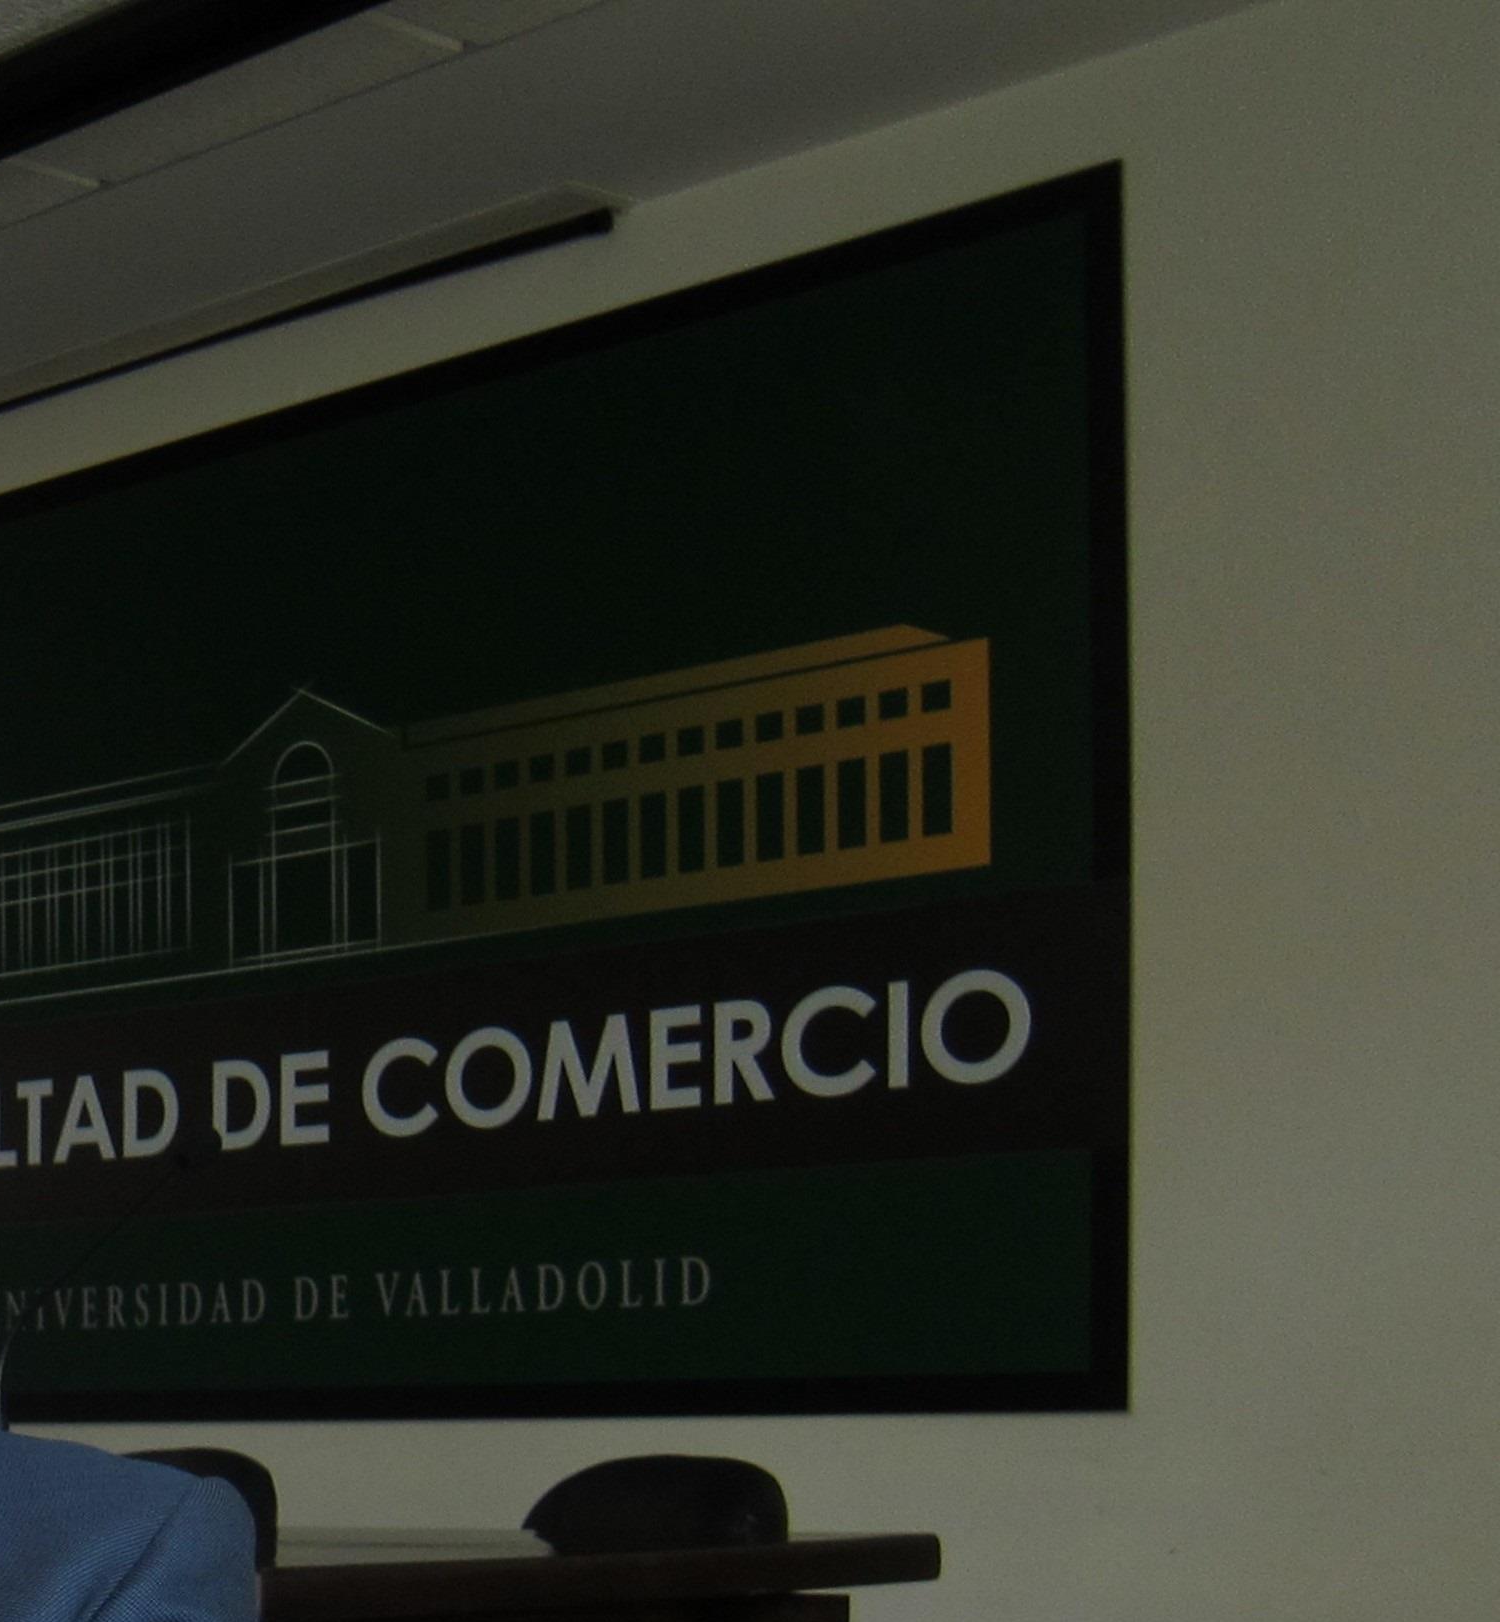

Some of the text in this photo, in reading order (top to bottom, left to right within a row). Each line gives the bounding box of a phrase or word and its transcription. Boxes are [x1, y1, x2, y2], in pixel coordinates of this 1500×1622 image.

[211, 1049, 331, 1152] DE
[361, 968, 1032, 1138] COMERCIO
[293, 1272, 350, 1322] DE
[374, 1255, 712, 1319] VALLADOLID
